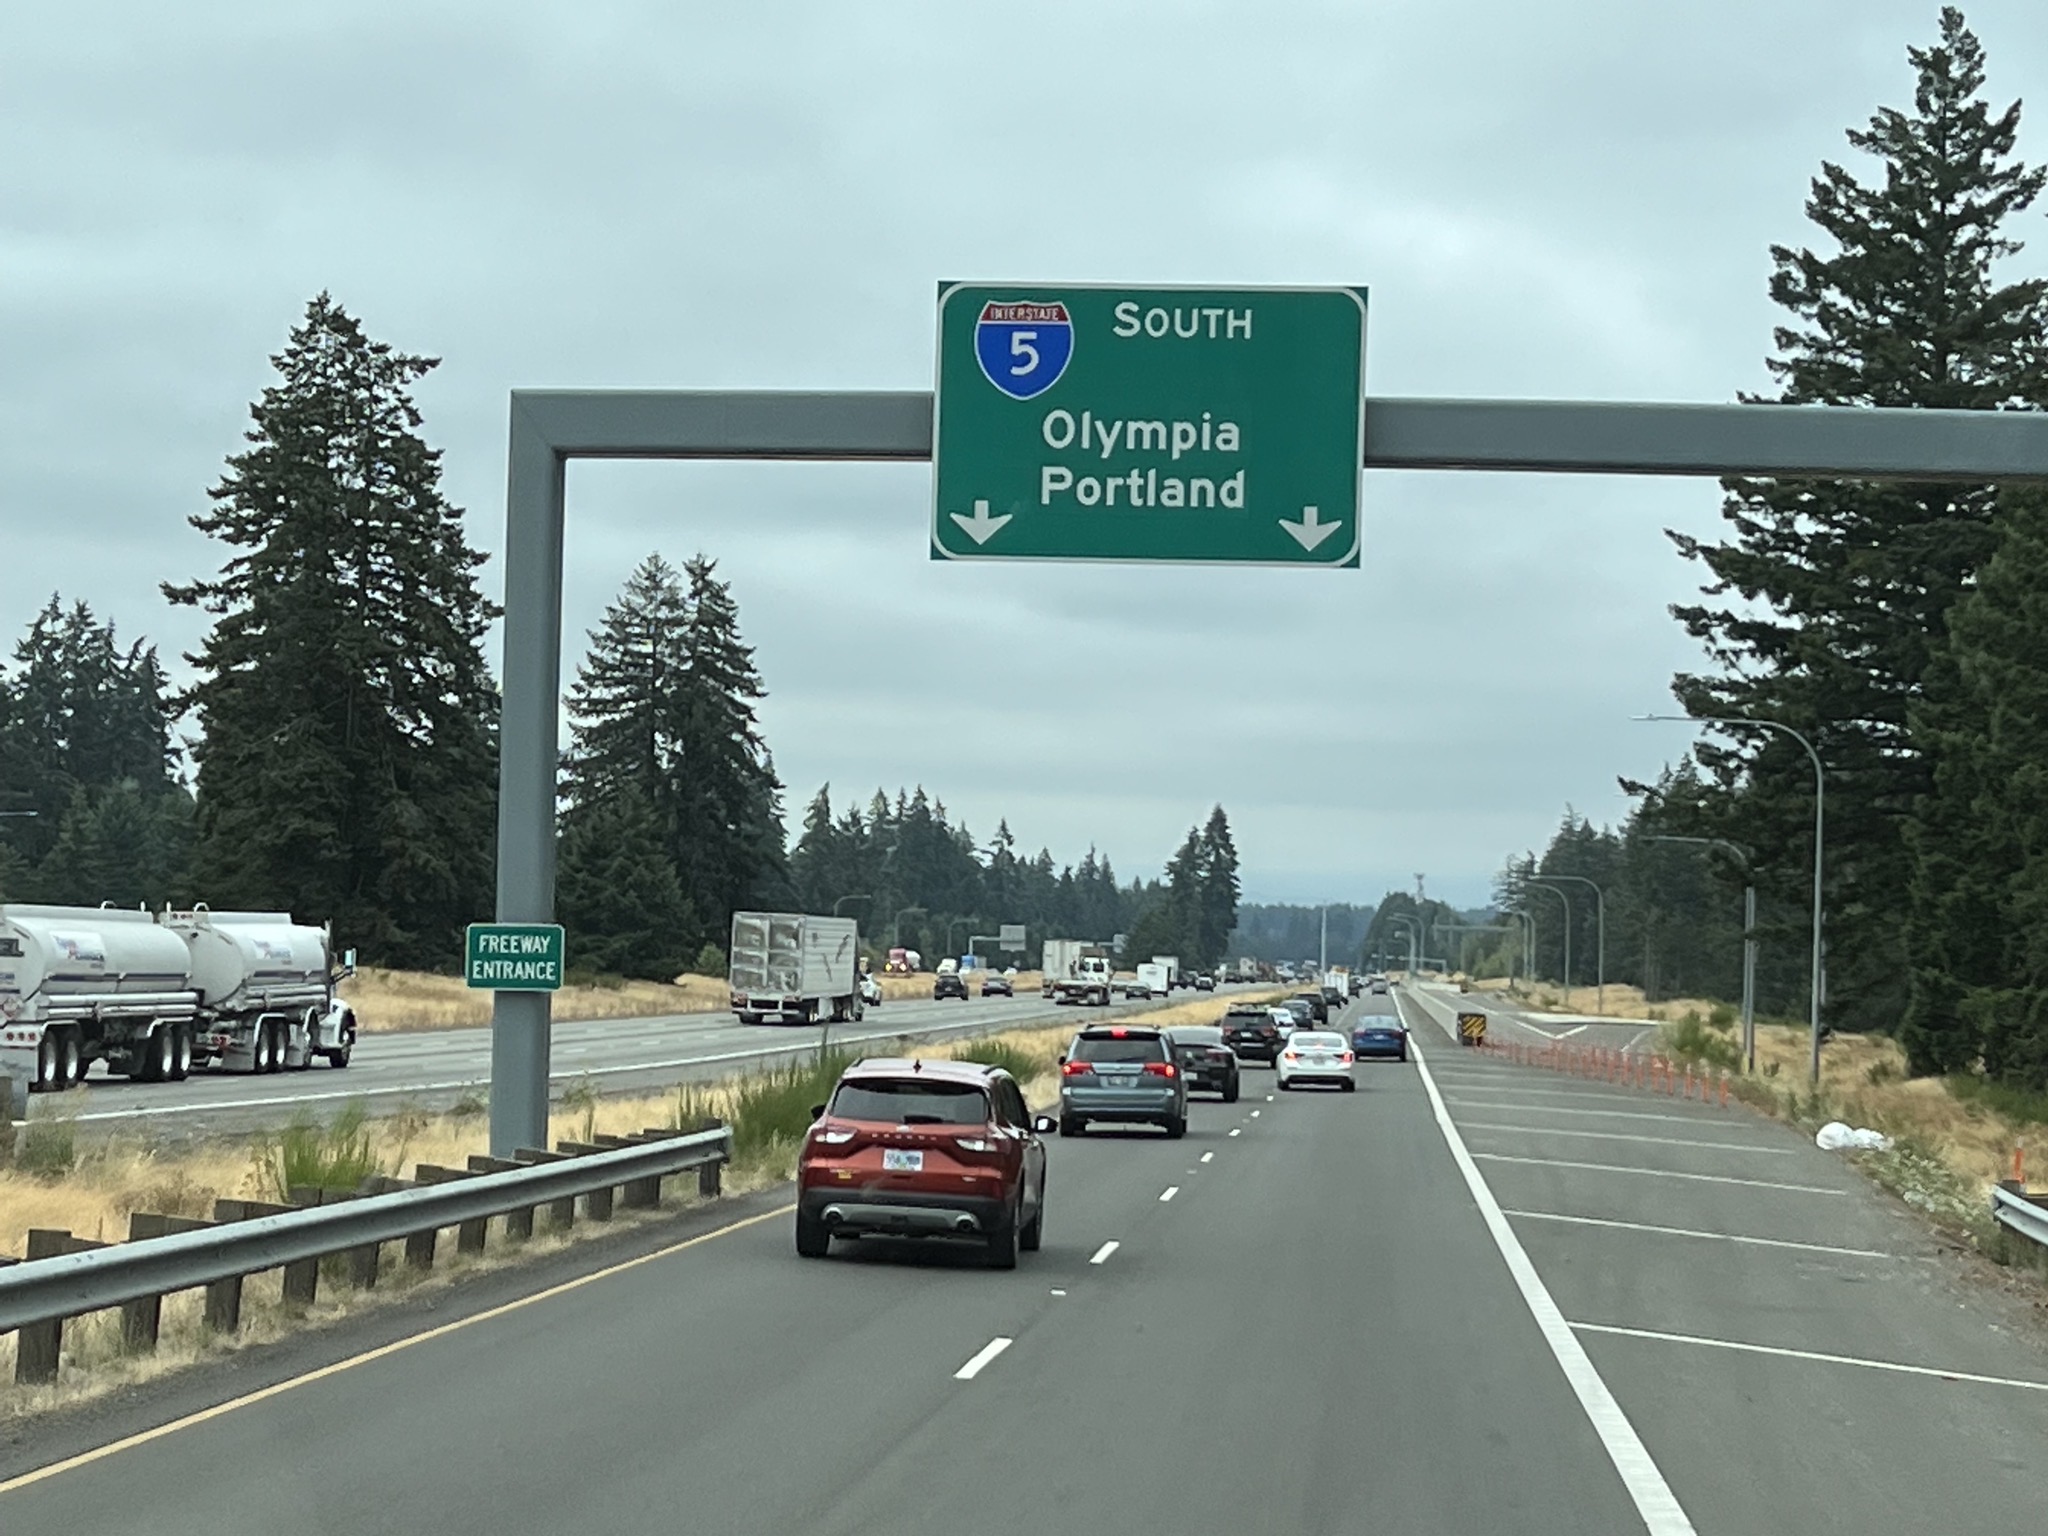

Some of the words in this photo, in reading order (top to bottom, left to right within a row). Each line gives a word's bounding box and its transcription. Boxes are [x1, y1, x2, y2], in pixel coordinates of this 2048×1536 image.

[990, 307, 1059, 321] INTERSTATE
[1112, 301, 1252, 340] SOUTH
[1010, 331, 1039, 376] 5
[1042, 409, 1240, 460] Olympia
[1040, 466, 1245, 509] Portland
[478, 934, 551, 954] FREEWAY
[472, 960, 556, 980] ENTRANCE
